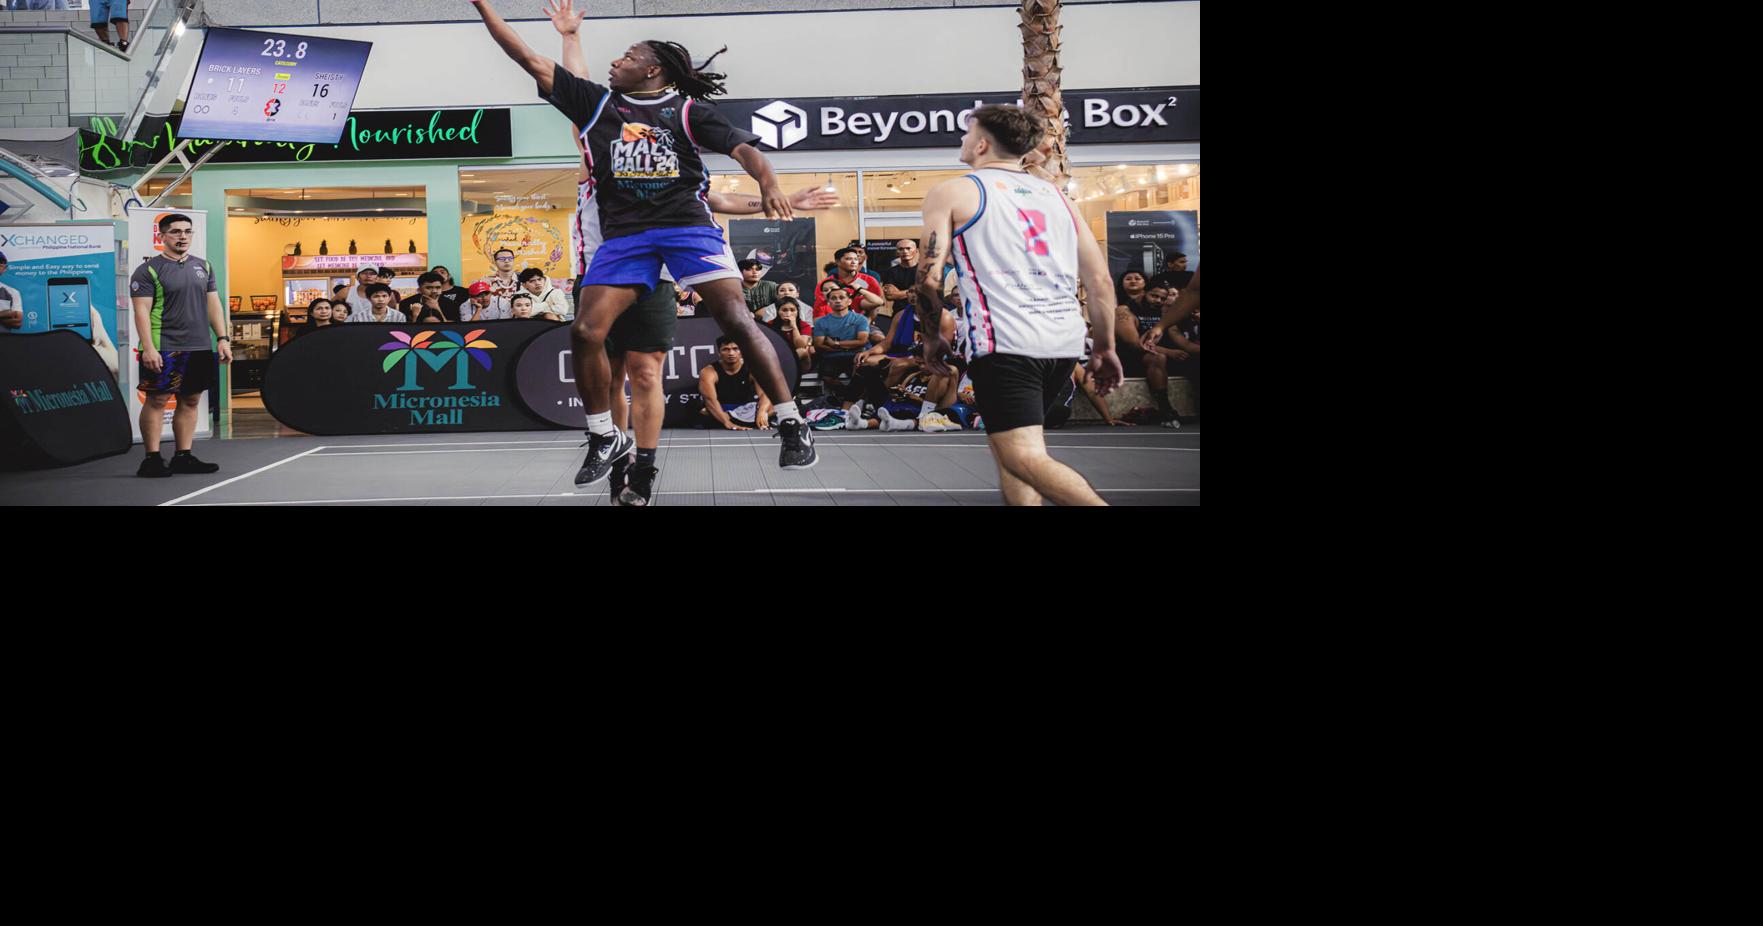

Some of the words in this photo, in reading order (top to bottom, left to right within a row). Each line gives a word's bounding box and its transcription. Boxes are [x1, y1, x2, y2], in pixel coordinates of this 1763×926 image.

[261, 38, 309, 59] 23.8
[208, 64, 231, 74] BRICK
[233, 66, 262, 76] LAYERS
[314, 72, 344, 81] SHEISTY
[226, 77, 245, 93] 11
[272, 82, 287, 94] 12
[311, 83, 330, 98] 16
[45, 263, 60, 271] Easy
[31, 384, 90, 413] Micronesia
[83, 380, 113, 403] Mall
[371, 391, 500, 410] Micronesia
[408, 408, 463, 426] Mall
